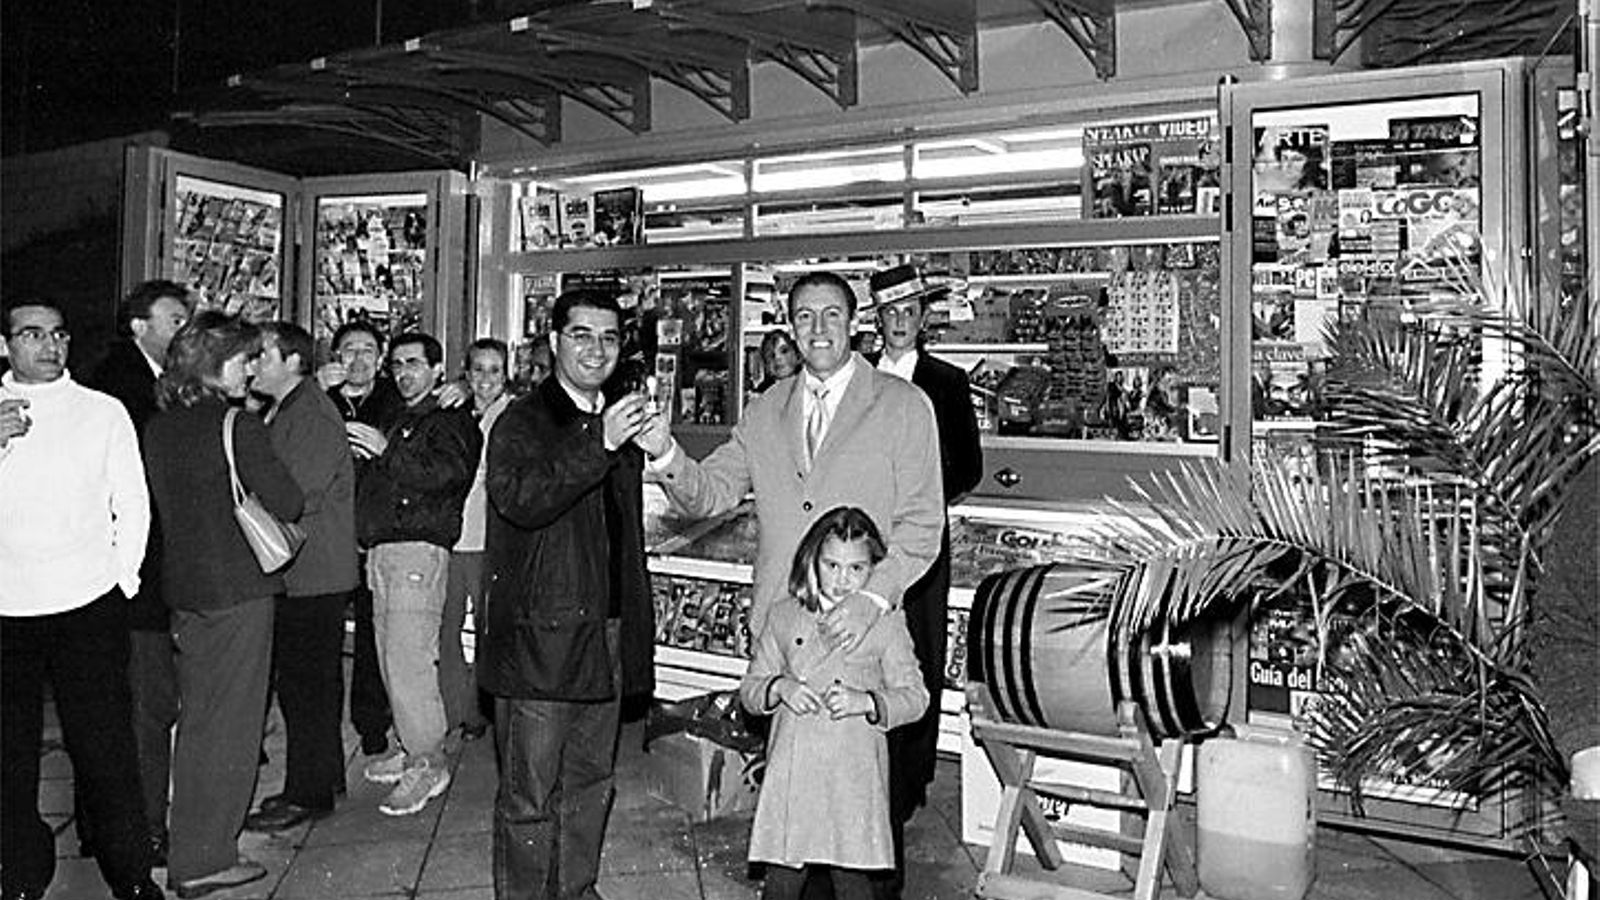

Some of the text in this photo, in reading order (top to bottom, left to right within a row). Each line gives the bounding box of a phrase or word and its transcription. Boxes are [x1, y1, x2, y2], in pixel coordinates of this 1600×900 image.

[1295, 268, 1316, 288] PC
[1250, 660, 1283, 686] Guía
[1286, 666, 1312, 691] del
